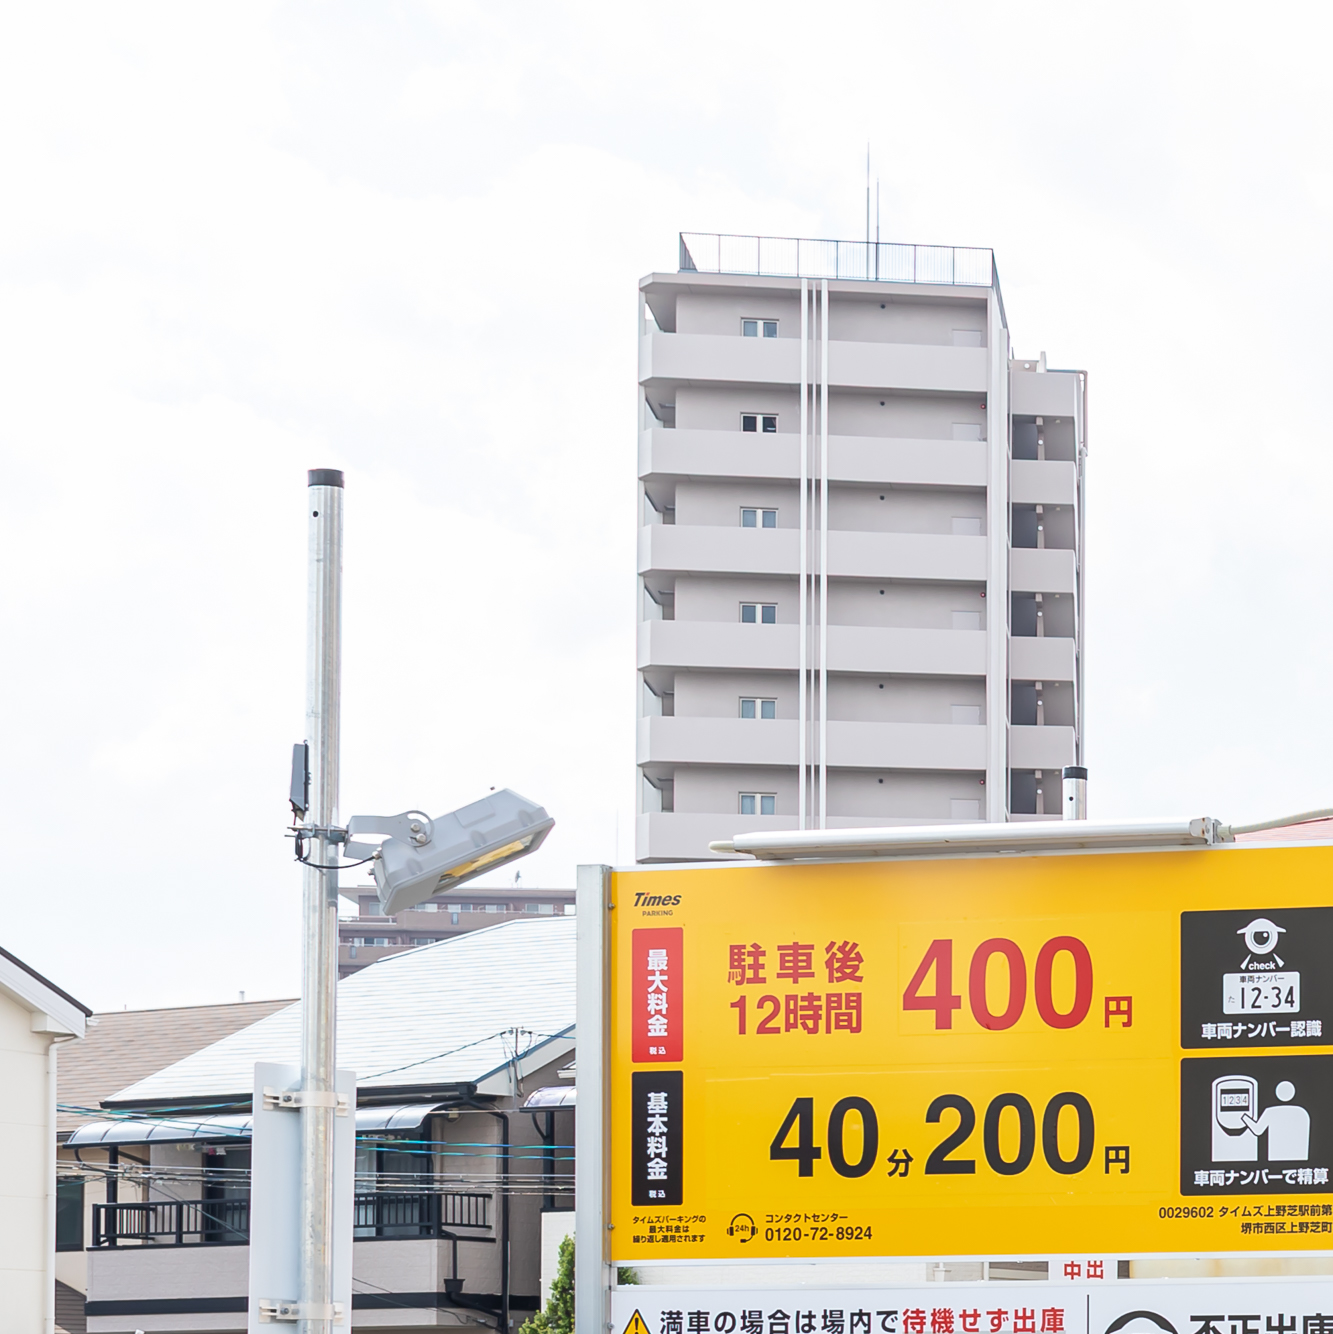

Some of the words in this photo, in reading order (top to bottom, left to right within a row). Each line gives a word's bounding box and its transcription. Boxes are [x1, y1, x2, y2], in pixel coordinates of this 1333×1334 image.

[634, 892, 682, 907] Times
[728, 940, 864, 985] 駐車後
[1248, 961, 1276, 970] check
[1239, 975, 1285, 984] 車両ナンバー
[646, 949, 669, 1037] 最大料金
[1240, 986, 1295, 1009] 12-34
[729, 992, 863, 1035] 12時間
[1201, 1020, 1322, 1040] 車両ナンバー認識
[649, 1047, 666, 1055] 税込
[1221, 1094, 1249, 1106] 1234
[646, 1092, 669, 1181] 基本料金
[1193, 1168, 1330, 1187] 車両ナンバーで精算
[649, 1190, 666, 1198] 税込
[765, 1213, 849, 1223] コンタクトセンター
[1159, 1206, 1214, 1219] 0029602
[632, 1215, 707, 1225] タイムズパーキングの
[649, 1225, 690, 1234] 最大料金は
[765, 1226, 873, 1241] 0120-72-8924
[632, 1234, 706, 1244] 繰り返し適用されます
